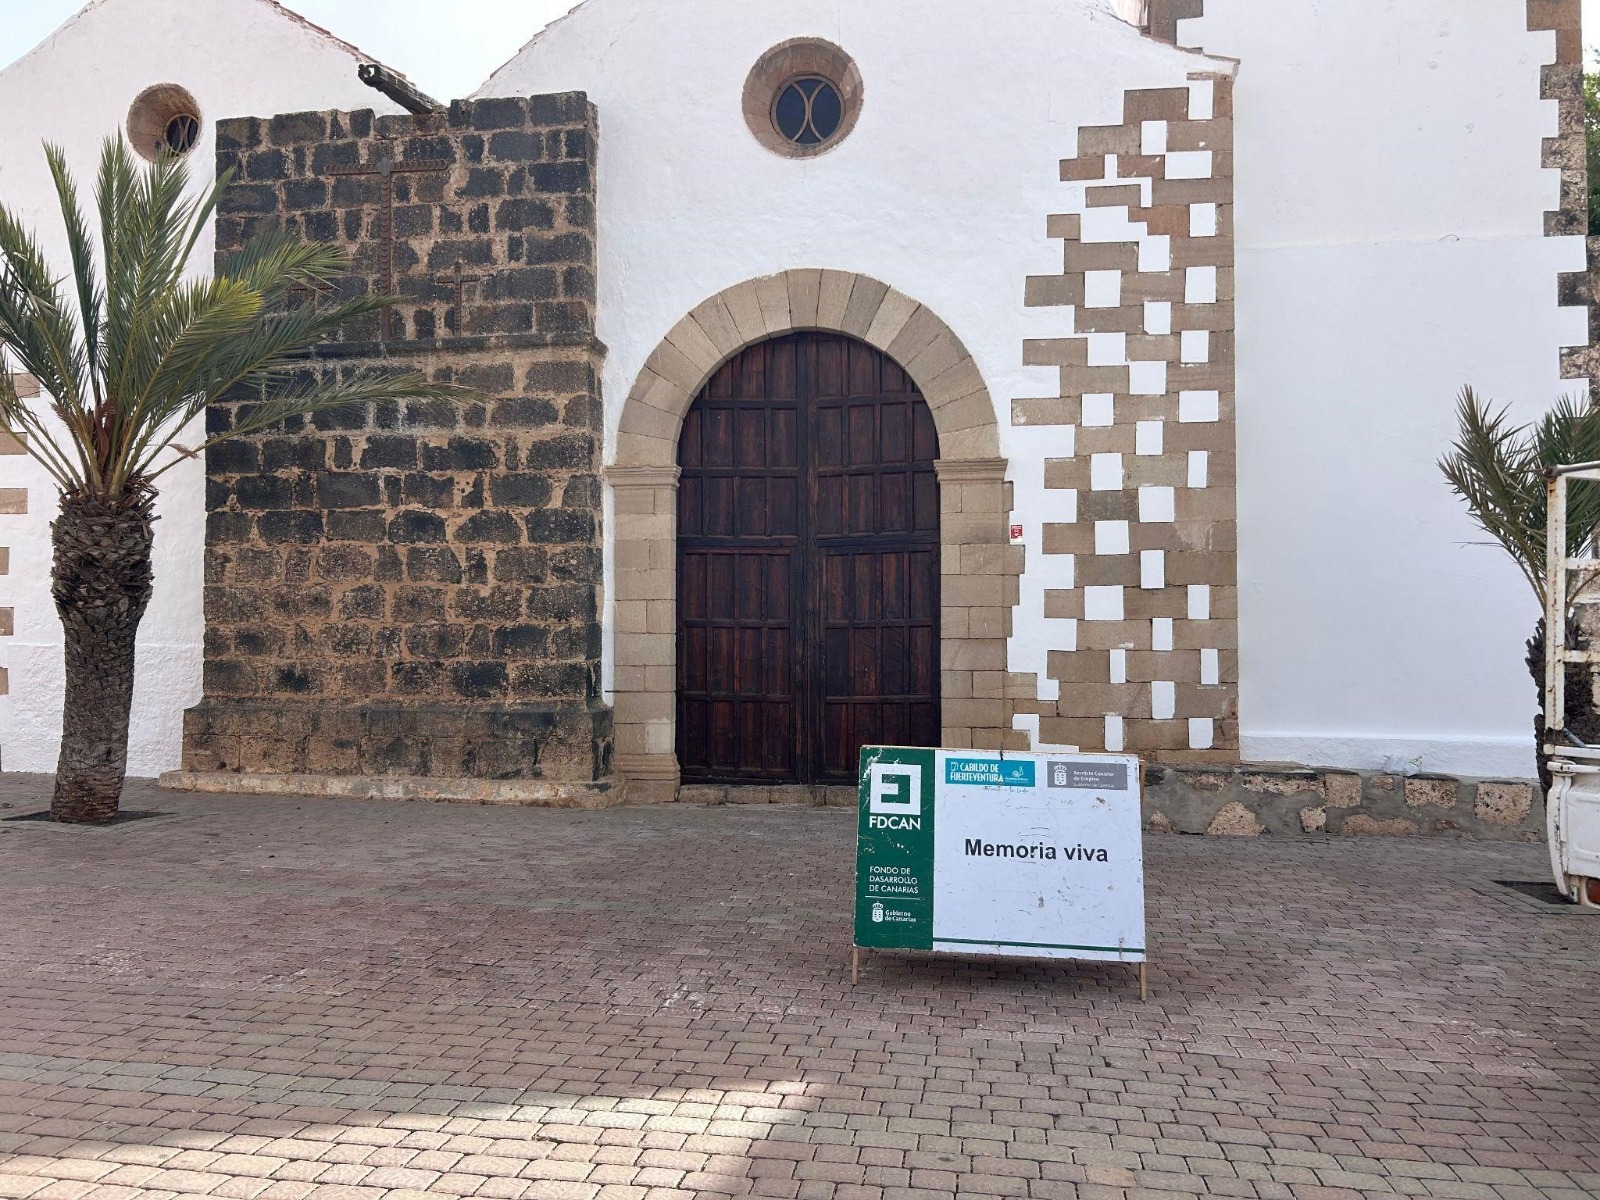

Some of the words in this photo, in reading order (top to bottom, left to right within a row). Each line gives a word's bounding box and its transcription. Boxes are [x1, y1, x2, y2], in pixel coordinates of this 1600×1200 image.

[960, 763, 988, 772] CABILDO
[990, 763, 999, 773] DE
[950, 772, 1004, 783] FUERTEVENTURA
[869, 816, 921, 830] FDCAN
[965, 838, 1057, 860] Memoria
[1063, 843, 1108, 862] viva
[869, 866, 899, 874] FONDO
[900, 867, 911, 875] DE
[869, 875, 918, 884] DASARROLLO
[869, 884, 879, 892] DE
[880, 885, 919, 894] CANARIAS
